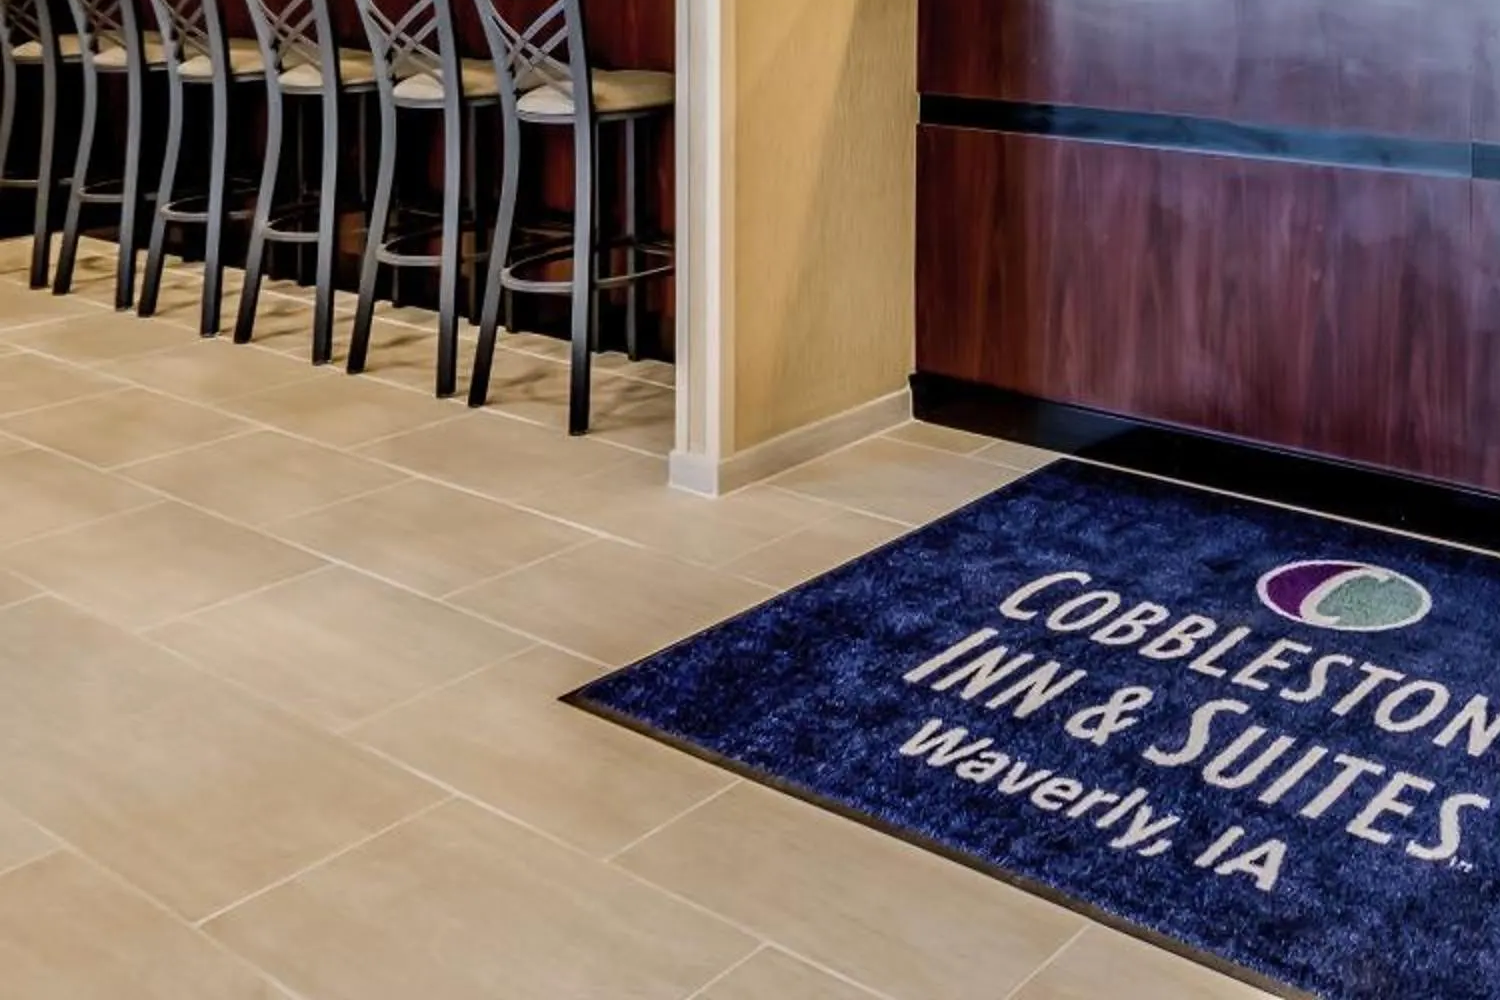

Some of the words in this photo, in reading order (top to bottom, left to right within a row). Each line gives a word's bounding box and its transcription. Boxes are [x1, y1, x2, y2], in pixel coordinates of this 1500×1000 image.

[900, 719, 1180, 857] Waverly,
[1194, 825, 1288, 892] IA
[903, 628, 1086, 719] INN
[1066, 686, 1152, 744] &
[1142, 699, 1491, 863] SUITES
